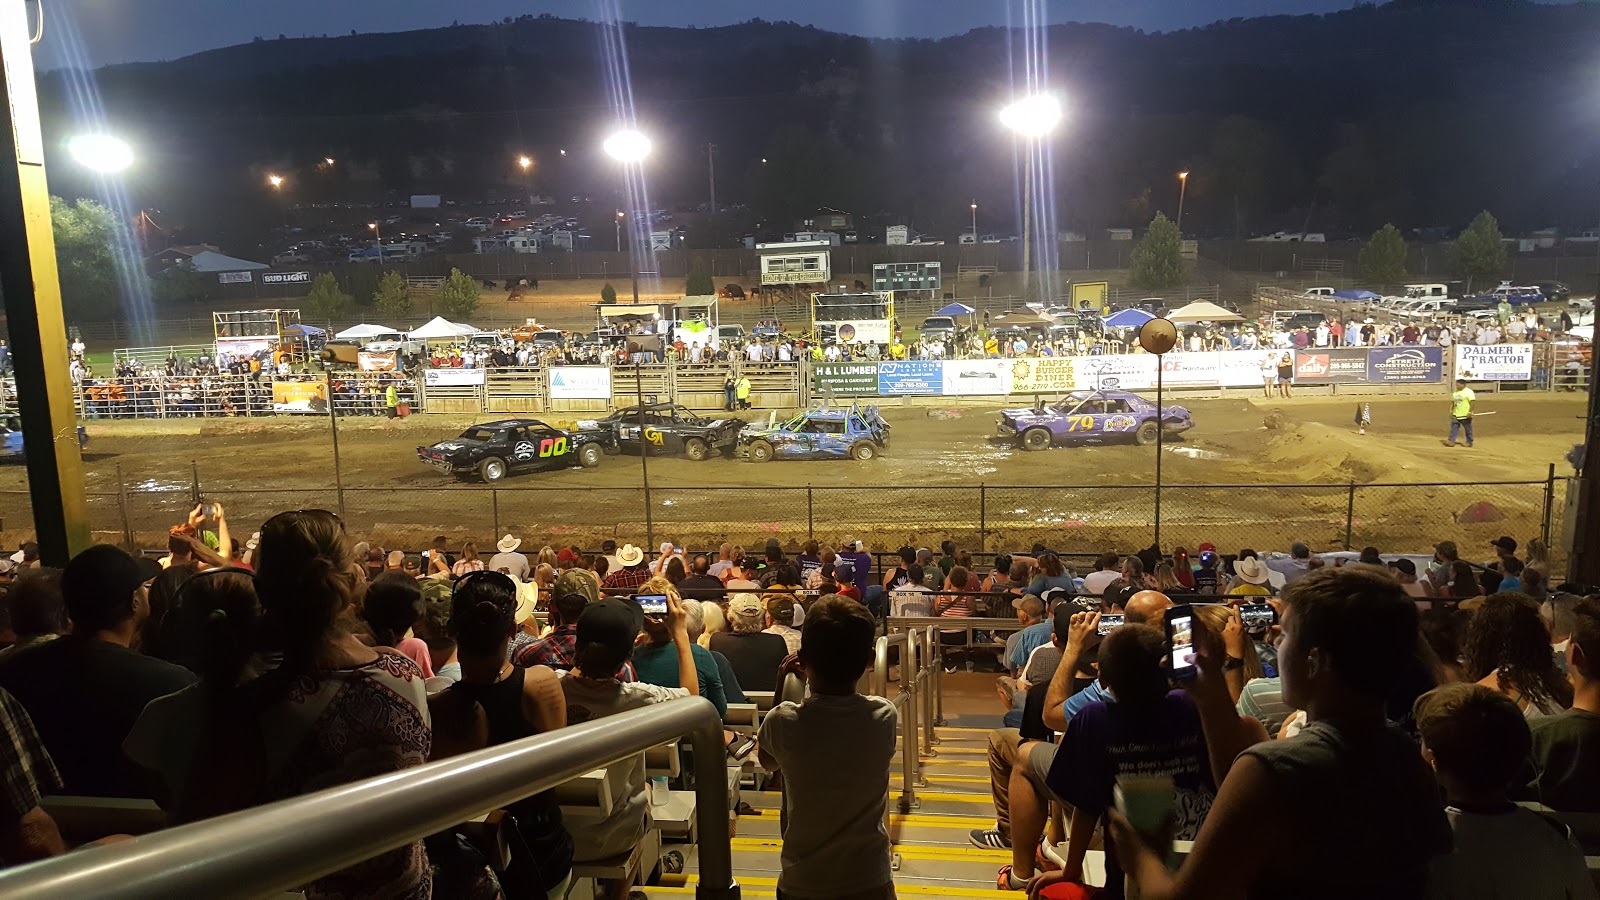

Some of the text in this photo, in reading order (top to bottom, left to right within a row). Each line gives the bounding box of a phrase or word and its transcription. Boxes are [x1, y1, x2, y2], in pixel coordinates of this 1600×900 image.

[1462, 346, 1513, 360] PALMER
[1469, 356, 1524, 368] TRACTOR
[817, 366, 877, 375] H & L LUMBER
[1068, 416, 1095, 432] 79
[1119, 761, 1134, 771] We
[1137, 760, 1161, 769] don't
